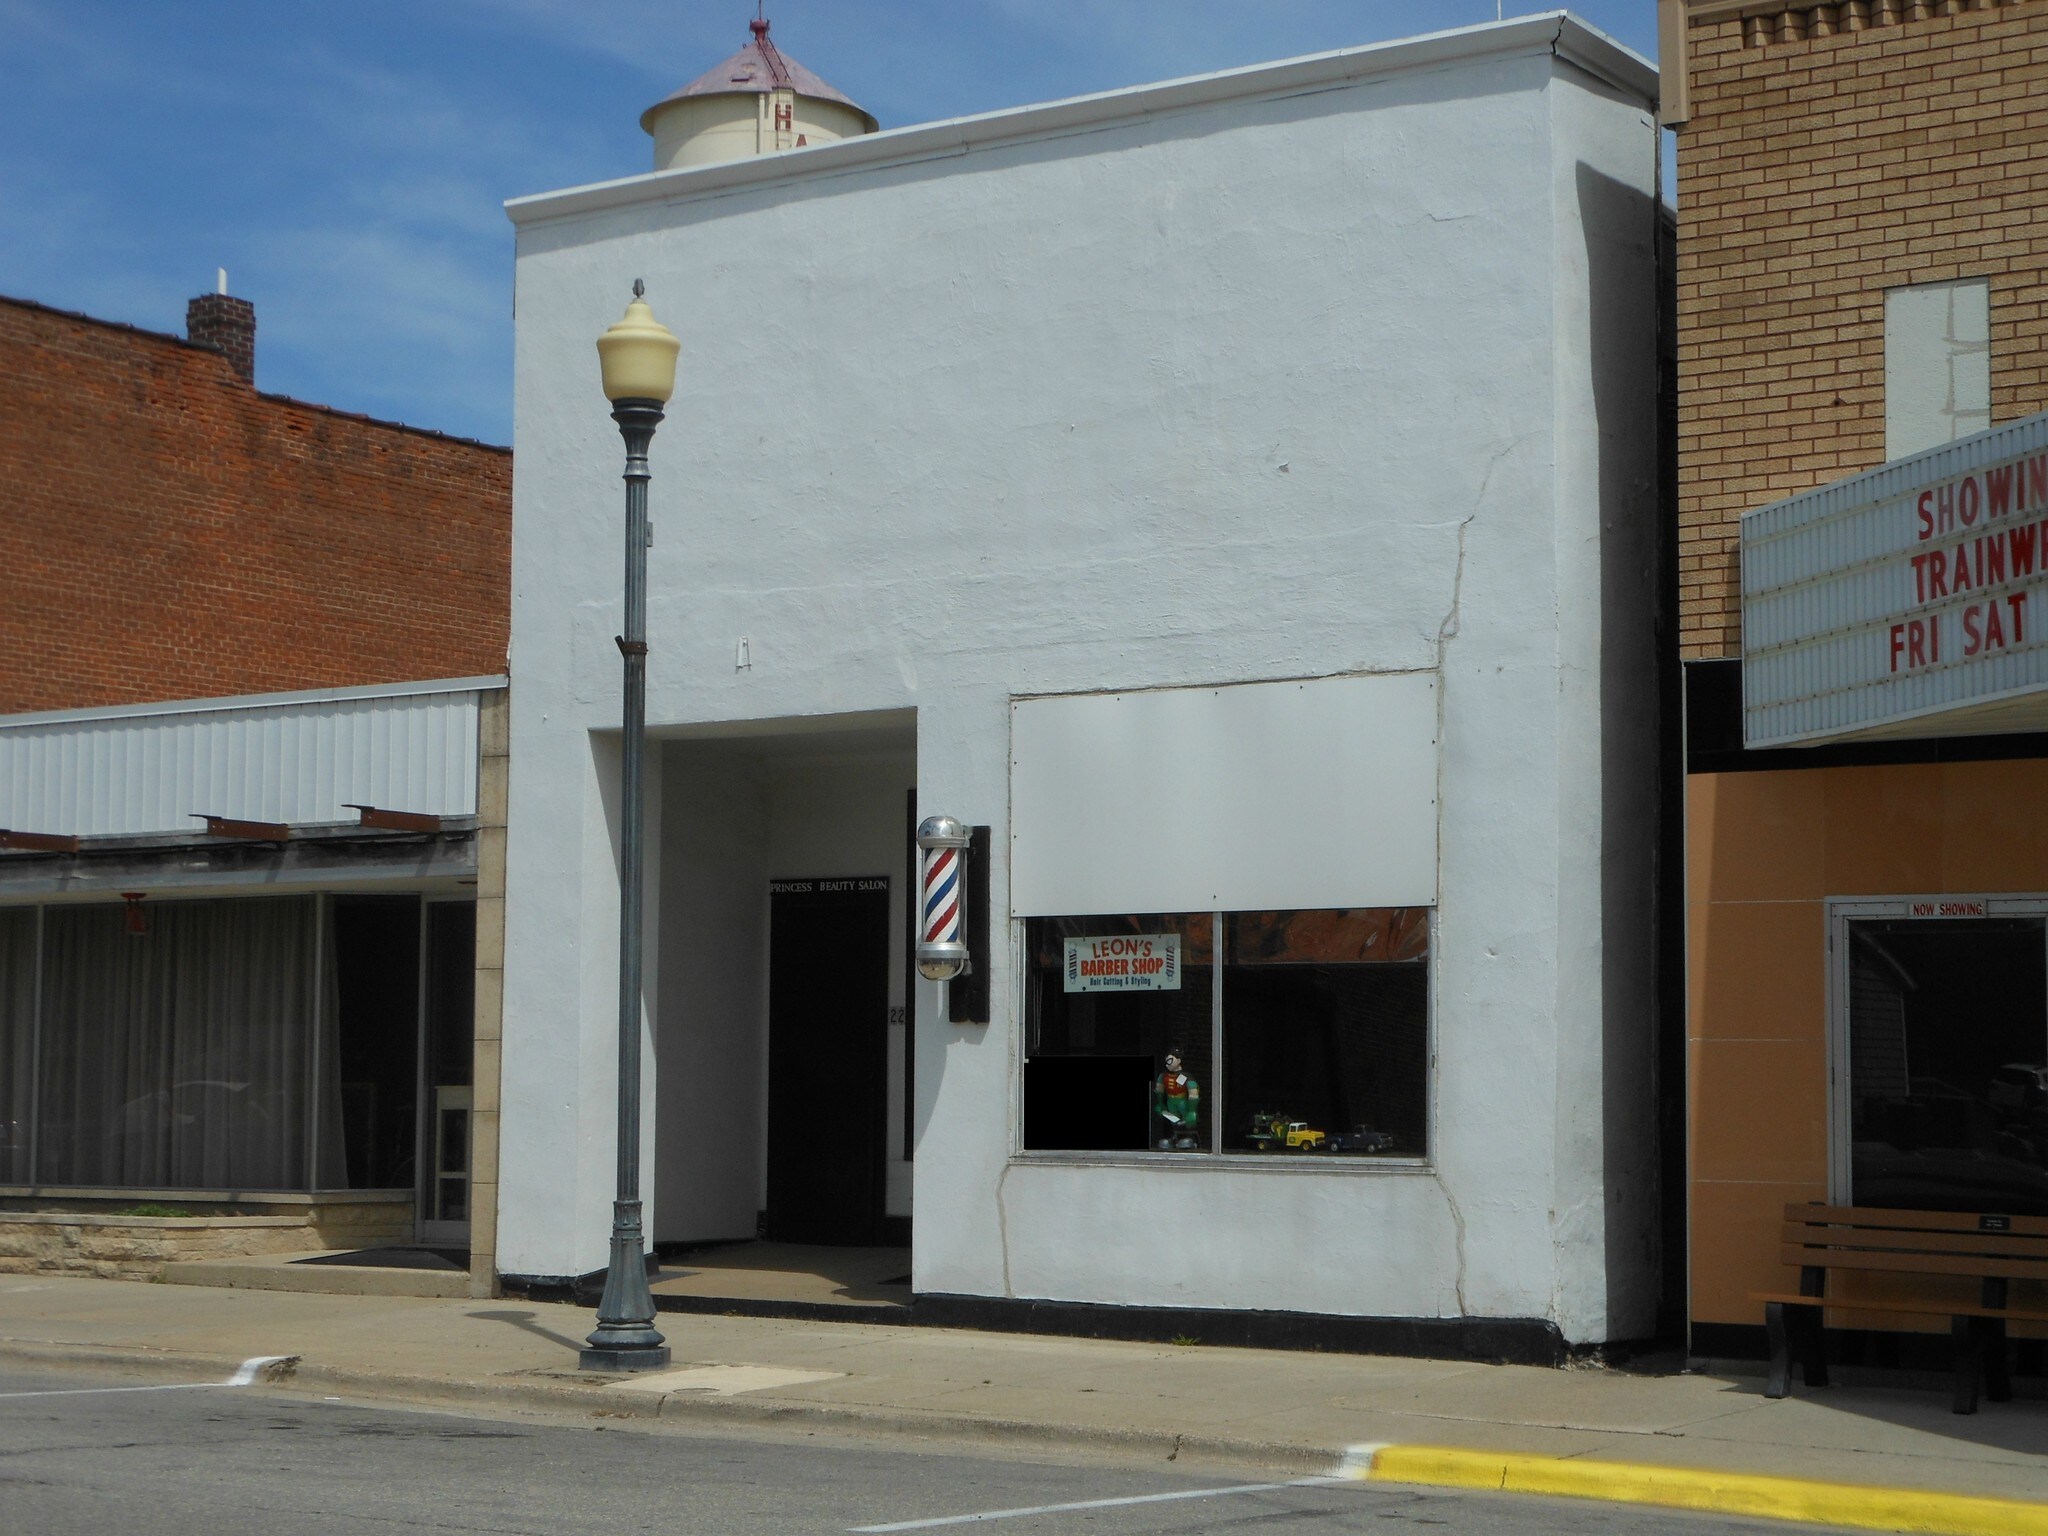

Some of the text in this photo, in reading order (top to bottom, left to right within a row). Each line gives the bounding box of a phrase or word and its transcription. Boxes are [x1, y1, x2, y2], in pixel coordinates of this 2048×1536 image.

[1917, 453, 2048, 540] SHOWIN
[1890, 592, 2027, 672] FRI SAT
[770, 880, 888, 893] PRINCESS BEAUTY SALON
[1913, 903, 1982, 916] NOW SHOWING
[1092, 938, 1153, 959] LEON'S
[1081, 957, 1164, 976] BARBER SHOP
[1089, 977, 1102, 986] Hair
[1103, 977, 1123, 987] Cutting
[1130, 976, 1151, 987] Styling
